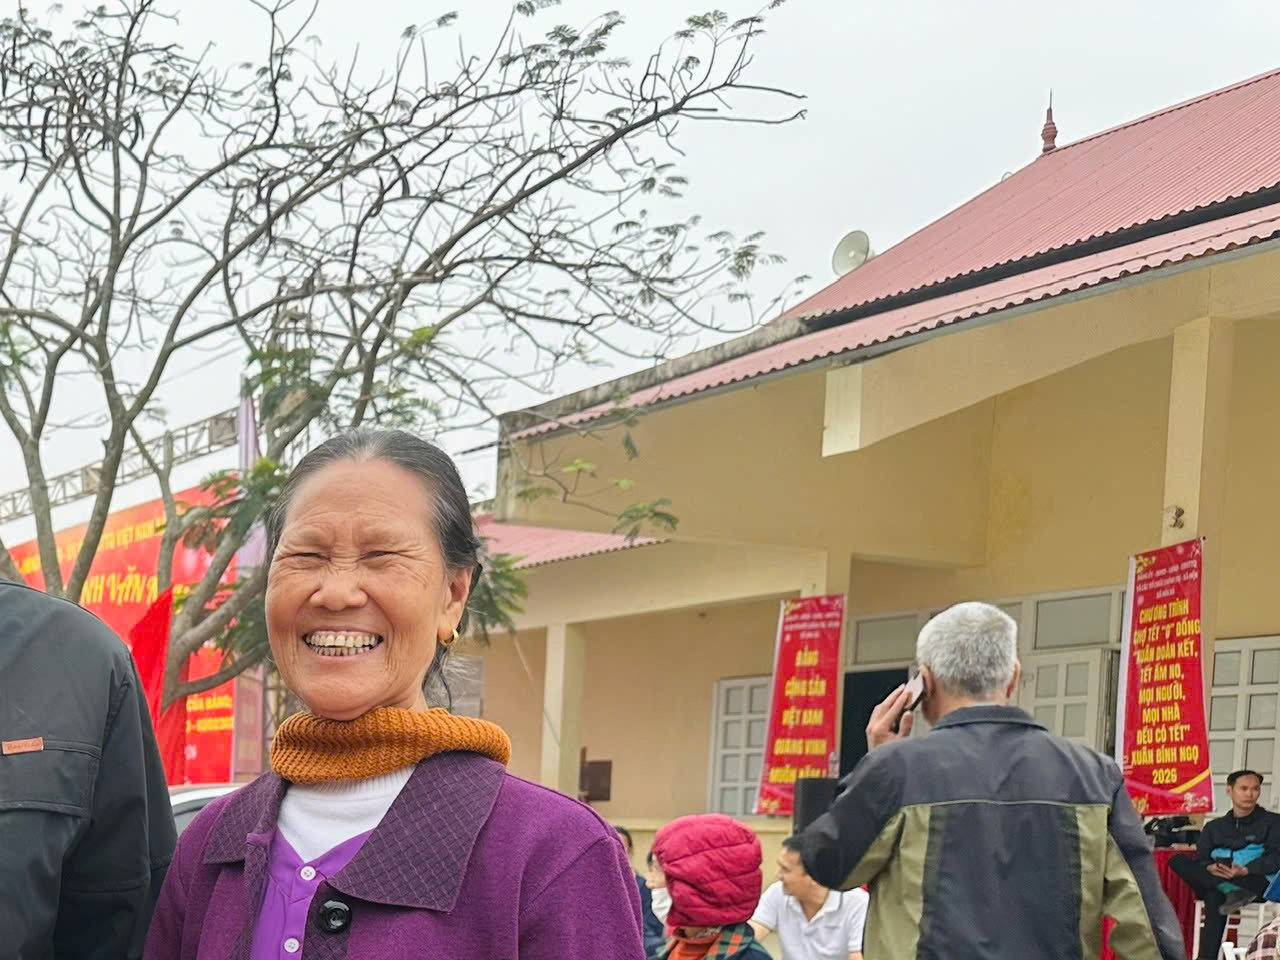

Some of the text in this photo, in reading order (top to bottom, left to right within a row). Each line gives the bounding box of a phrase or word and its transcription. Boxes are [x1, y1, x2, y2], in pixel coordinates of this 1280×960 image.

[1139, 598, 1189, 624] CHƯƠNG TRÌNH
[1148, 623, 1160, 642] TẾT
[1176, 617, 1200, 637] ĐỒNG
[1156, 641, 1176, 662] ĐOÀN
[1177, 637, 1198, 658] KẾT,
[1140, 664, 1153, 683] TẾT
[1154, 661, 1168, 681] ẤM
[1138, 680, 1186, 706] MỌI NGƯỜI,
[782, 705, 824, 728] VIỆT NAM
[1142, 702, 1180, 726] MỌI NHÀ
[1136, 724, 1153, 745] ĐỀU
[1155, 723, 1167, 743] CÓ
[1131, 744, 1199, 766] XUÂN BÍNH NGỌ
[1152, 768, 1177, 784] 2026
